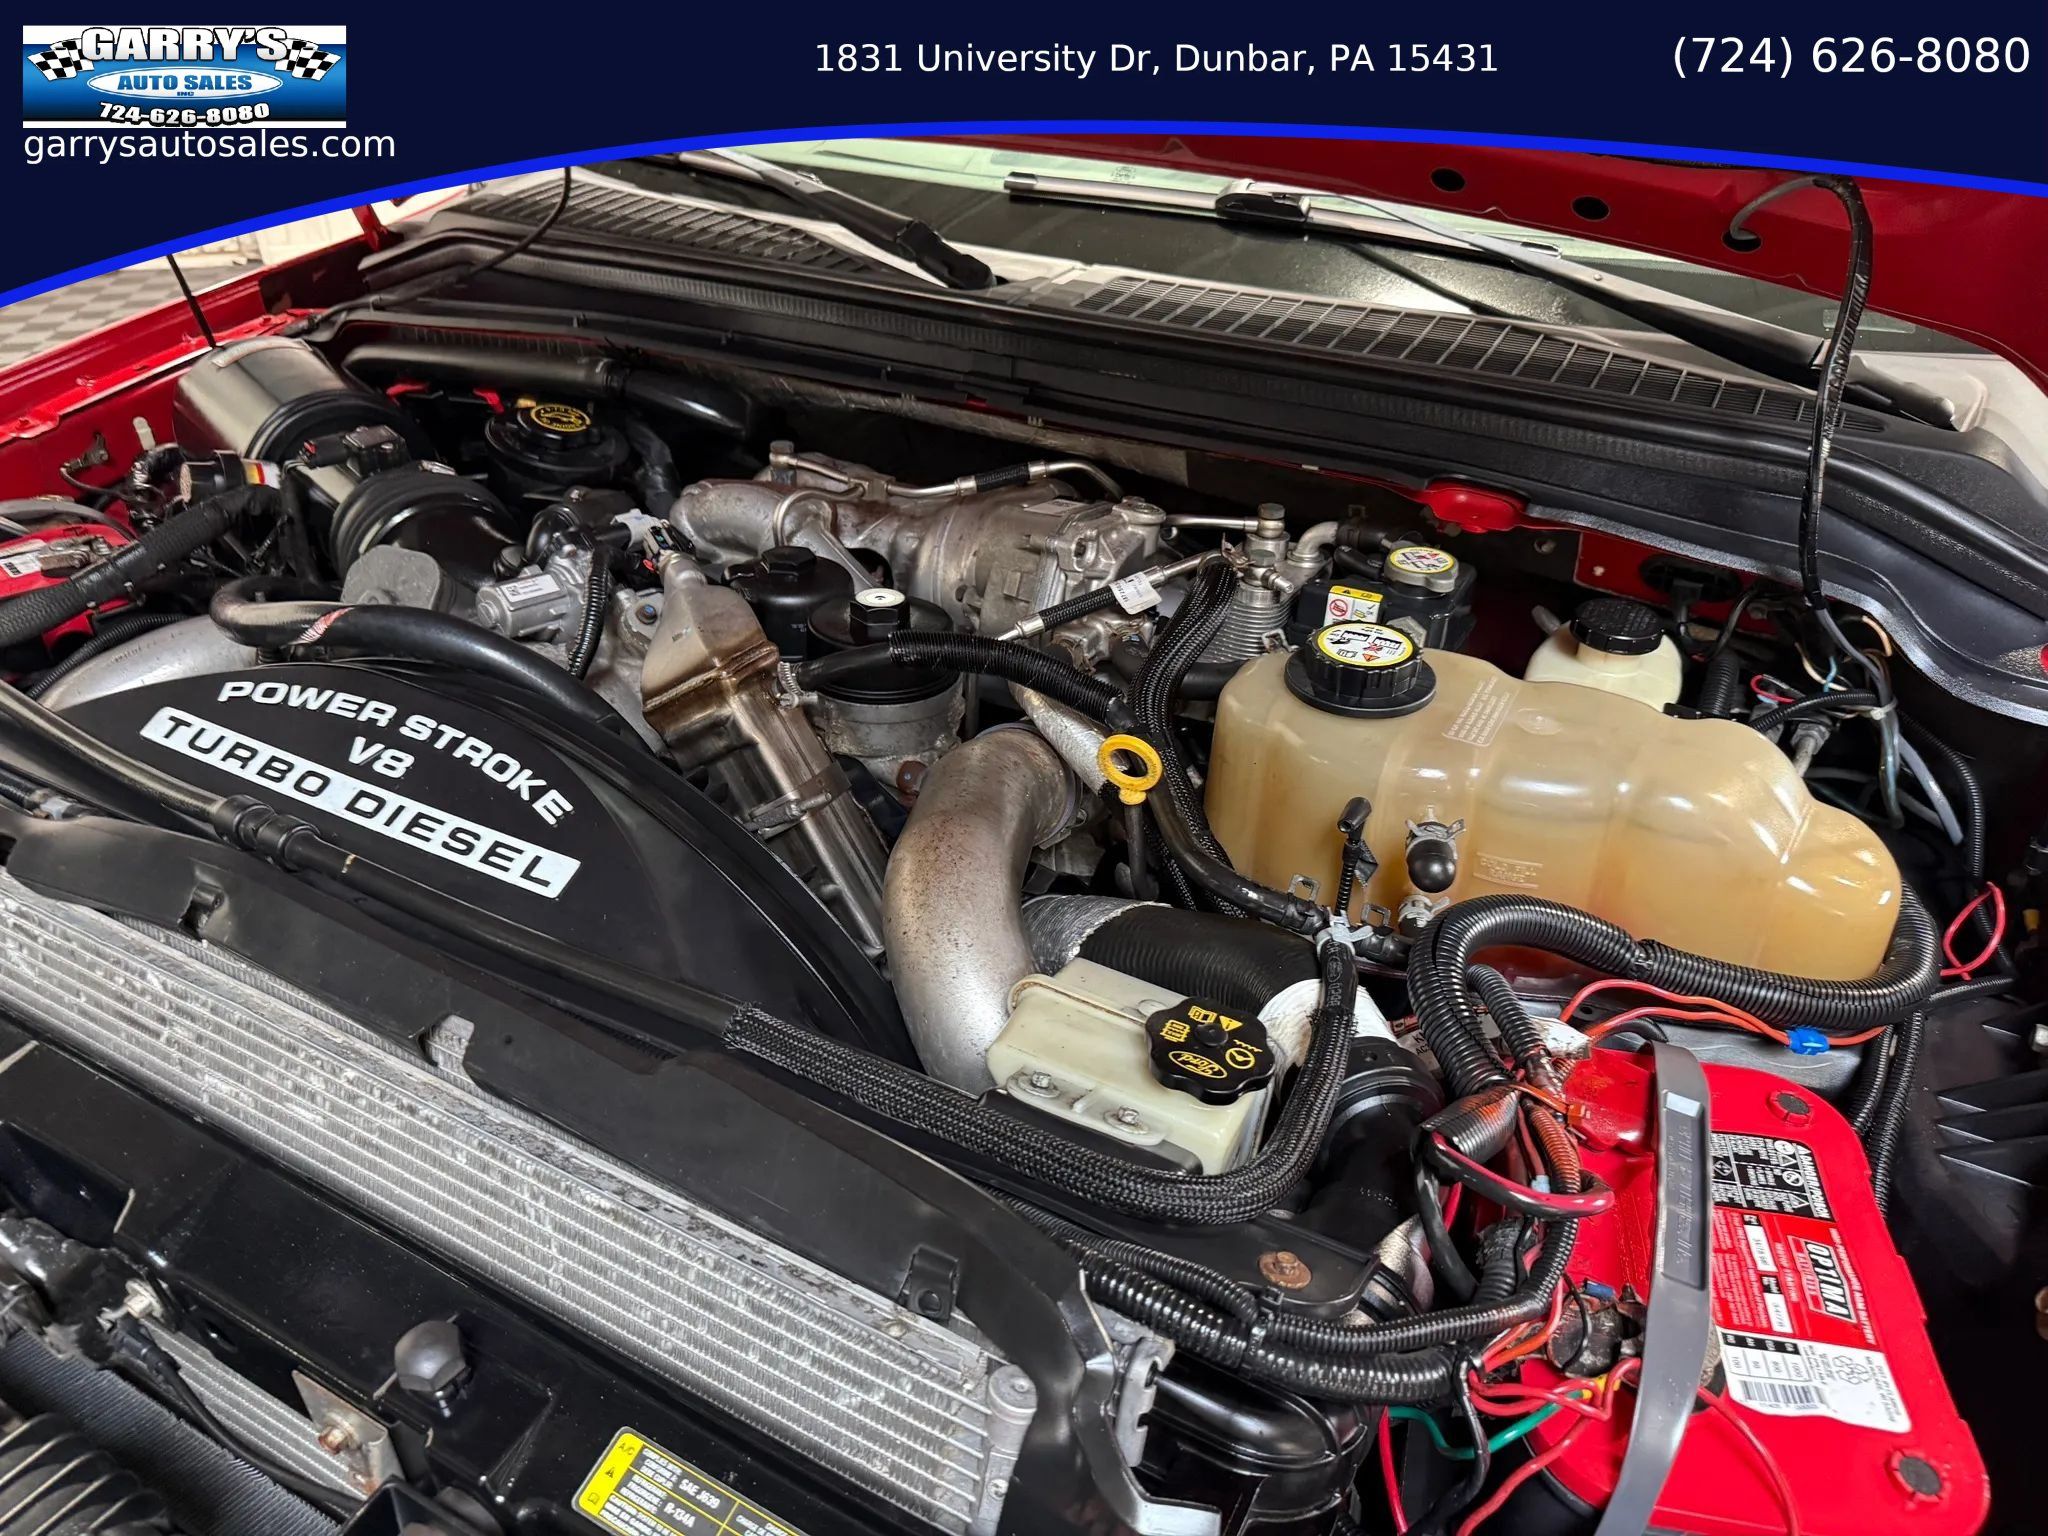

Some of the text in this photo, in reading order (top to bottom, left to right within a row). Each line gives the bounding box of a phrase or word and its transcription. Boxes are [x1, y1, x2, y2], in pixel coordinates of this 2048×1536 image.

[217, 680, 575, 828] POWER STROKE
[347, 735, 416, 780] V8
[160, 714, 555, 889] TURBO DIESEL
[1176, 1052, 1220, 1076] Ford
[1805, 1242, 1852, 1315] OPTIMA
[618, 1442, 635, 1456] A/C
[679, 1478, 700, 1496] SAE
[696, 1490, 720, 1509] J639
[664, 1502, 697, 1528] R-134A
